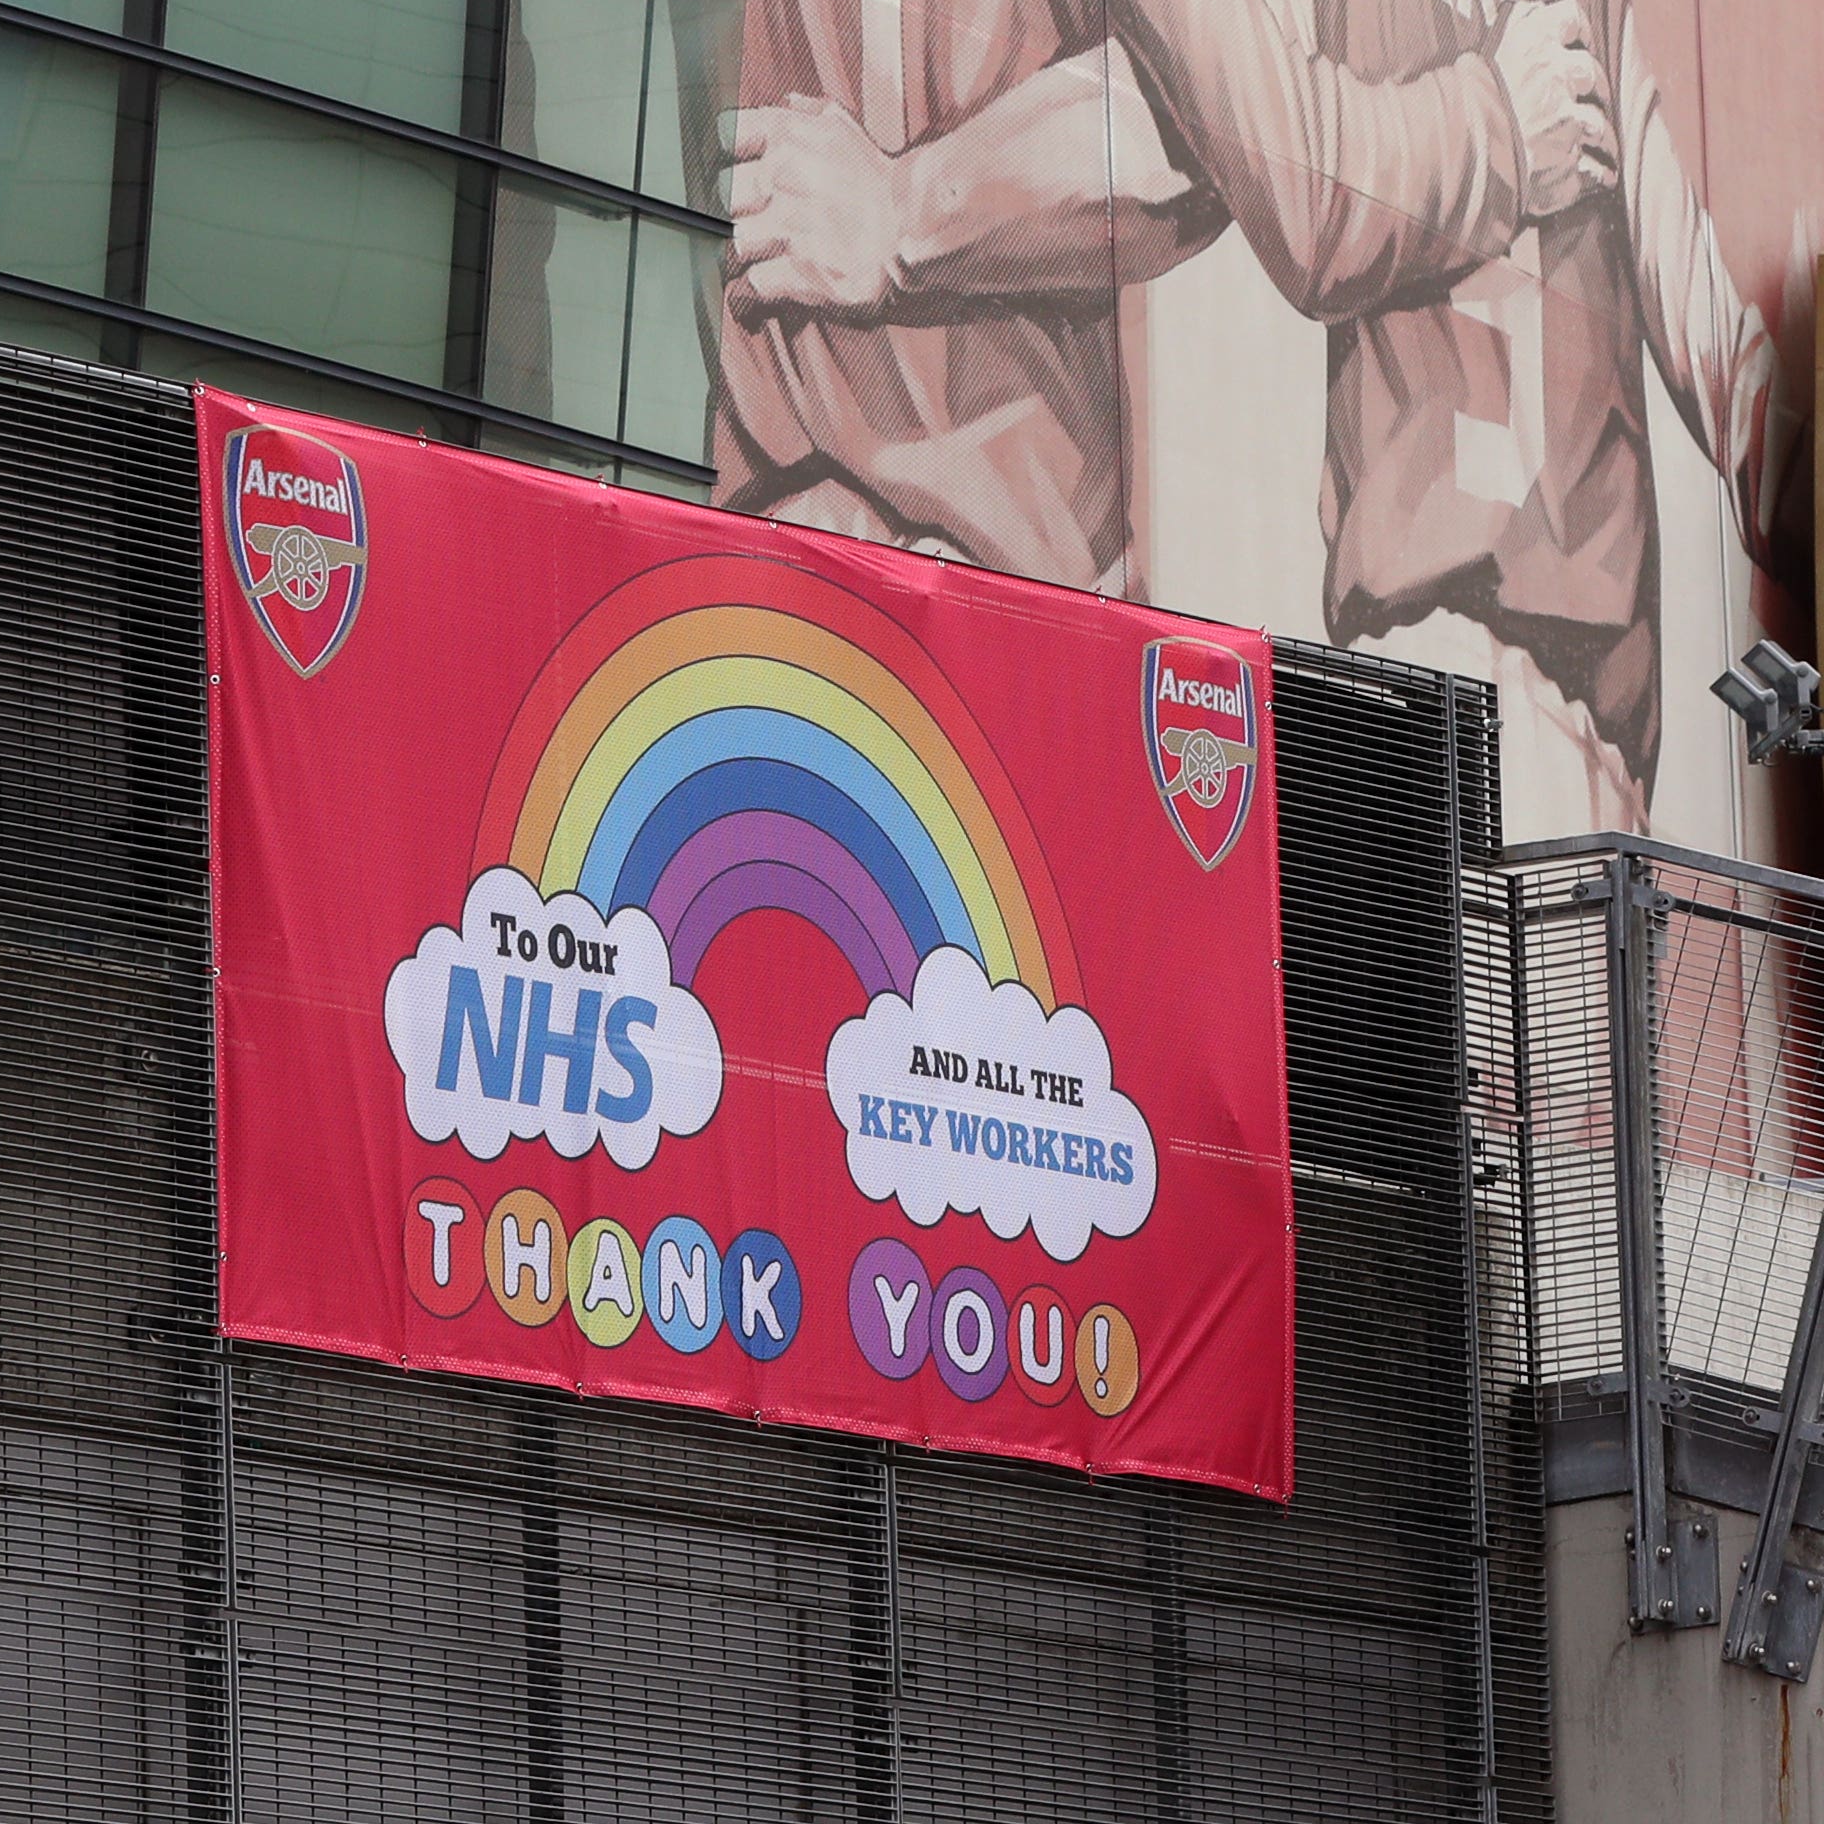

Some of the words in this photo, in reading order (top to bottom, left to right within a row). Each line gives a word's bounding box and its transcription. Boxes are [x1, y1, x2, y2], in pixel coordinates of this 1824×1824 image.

[242, 458, 349, 516] Arsenal
[1158, 667, 1243, 718] Arsenal
[490, 911, 538, 962] To
[547, 923, 619, 976] Our
[435, 964, 659, 1124] NHS
[909, 1044, 969, 1084] AND
[974, 1057, 1025, 1097] ALL
[1030, 1068, 1085, 1108] THE
[858, 1092, 939, 1148] KEY
[944, 1107, 1135, 1186] WORKERS
[416, 1198, 787, 1343] THANK
[873, 1272, 1111, 1400] YOU!
